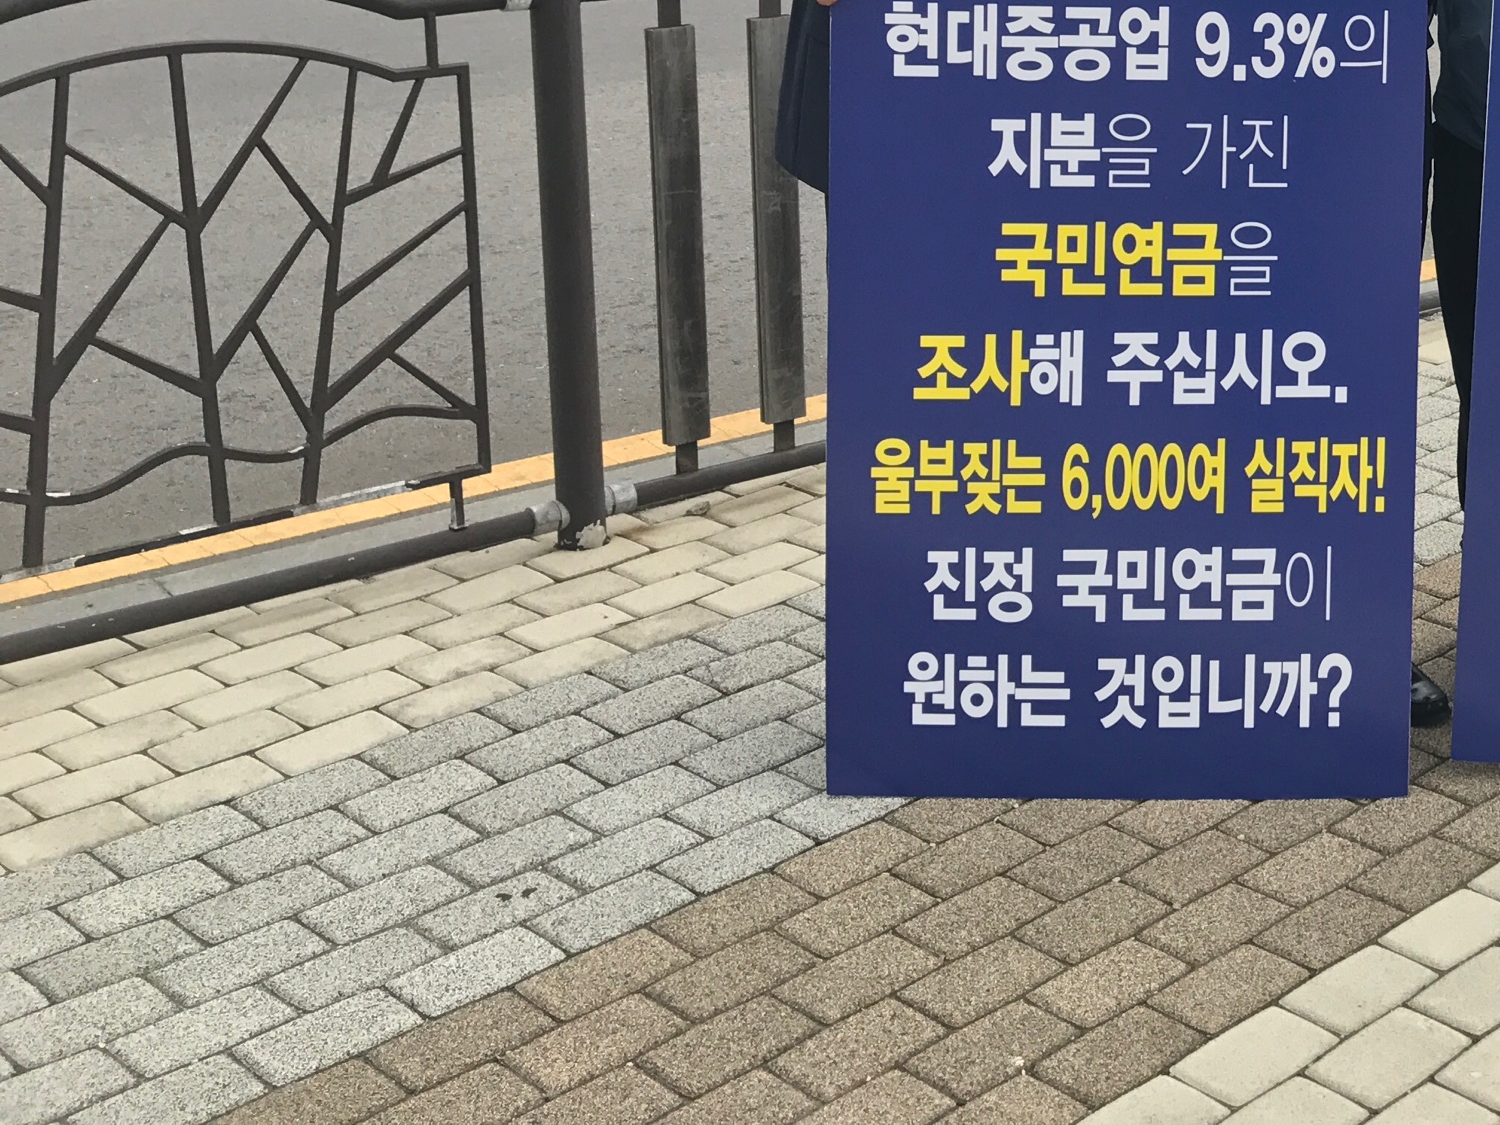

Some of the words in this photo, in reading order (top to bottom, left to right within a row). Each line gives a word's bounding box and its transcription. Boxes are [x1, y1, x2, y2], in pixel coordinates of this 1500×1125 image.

[884, 0, 1170, 82] 현대중공업
[1195, 9, 1389, 84] 9.3%의
[987, 112, 1158, 189] 지분을
[1181, 114, 1289, 189] 가진
[995, 220, 1279, 298] 국민연금을
[912, 329, 1084, 407] 조사해
[1106, 328, 1348, 406] 주십시오.
[870, 437, 1046, 515] 울부짖는
[1062, 437, 1226, 519] 6,000여
[1244, 436, 1387, 514] 실직자!
[923, 546, 1034, 624] 진정
[1056, 545, 1332, 623] 국민연금이
[903, 651, 1071, 728] 원하는
[1093, 652, 1353, 729] 것입니까?
